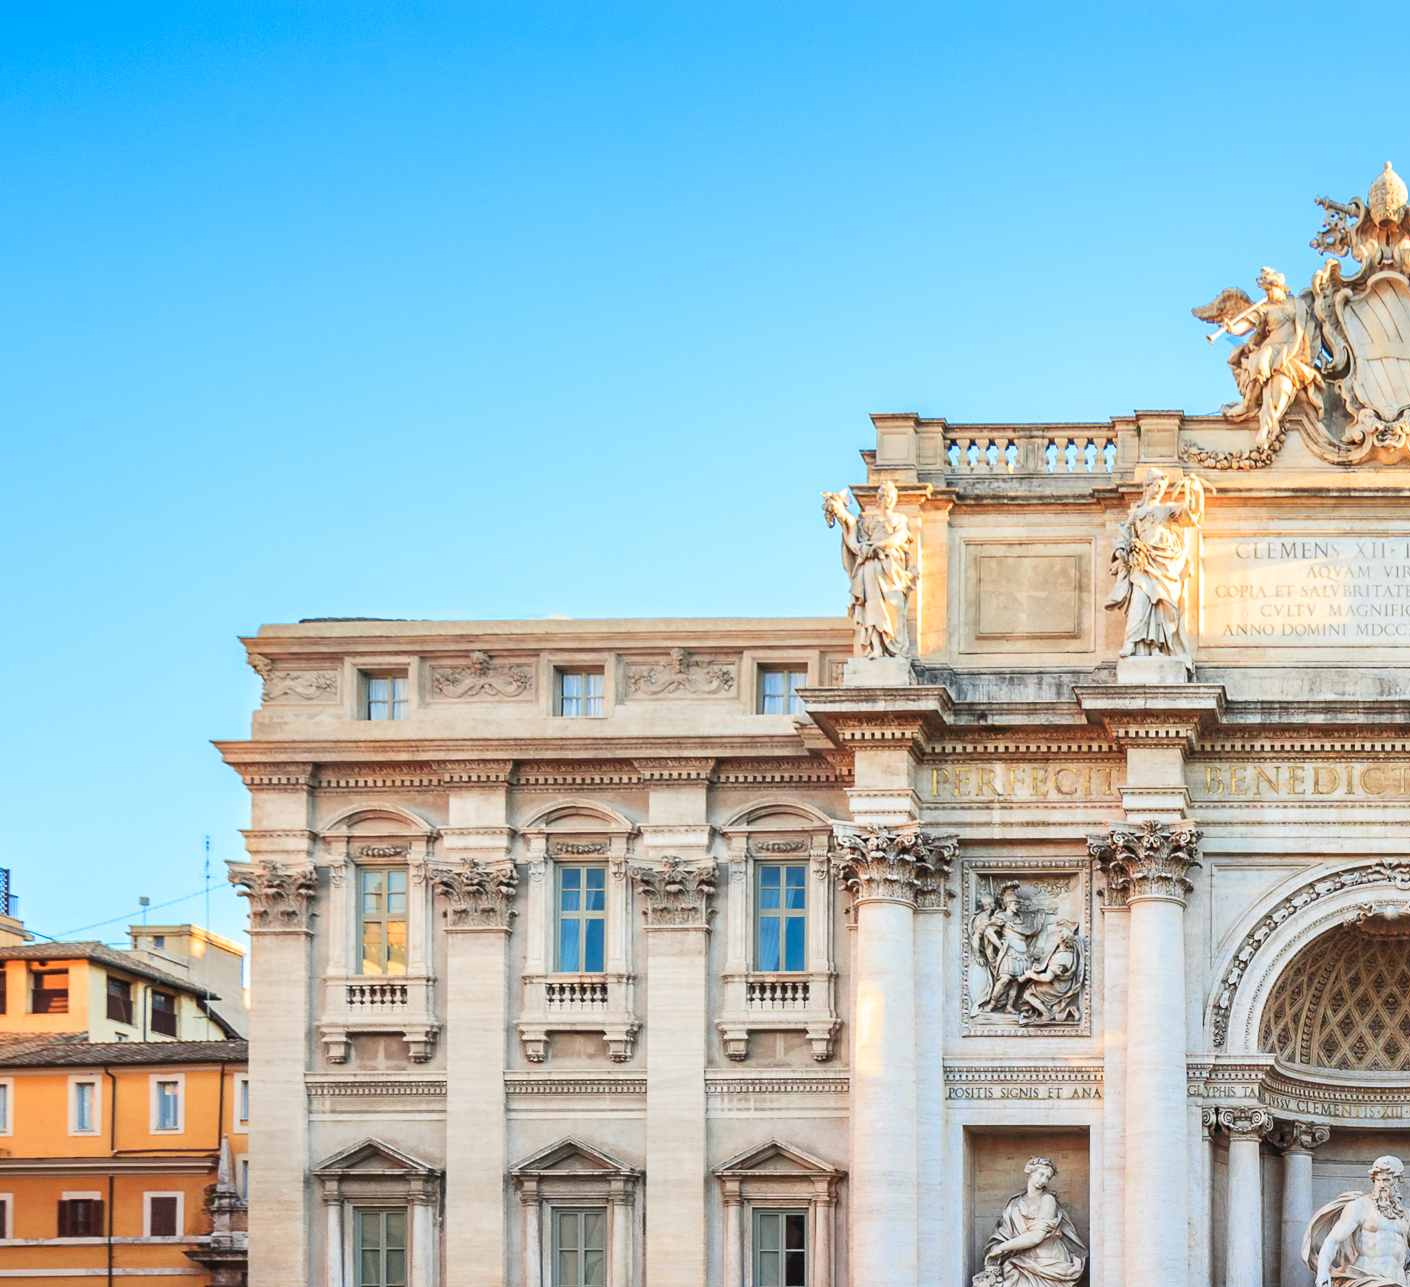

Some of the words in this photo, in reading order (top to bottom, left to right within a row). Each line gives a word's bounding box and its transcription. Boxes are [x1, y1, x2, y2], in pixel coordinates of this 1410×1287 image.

[1236, 542, 1340, 559] CLEMENS
[1306, 566, 1371, 582] AQVAM
[1215, 585, 1266, 598] COPIA
[1275, 585, 1295, 598] ET
[1260, 604, 1317, 617] CVLTV
[1222, 623, 1275, 637] ANNO
[1282, 623, 1346, 637] DOMINI
[931, 767, 1120, 796] PERFECIT
[948, 1087, 993, 1098] POSITIS
[1000, 1087, 1039, 1098] SIGNIS
[1049, 1087, 1063, 1098] ET
[1072, 1087, 1102, 1098] ANA
[1187, 1085, 1236, 1098] GLYPHIS
